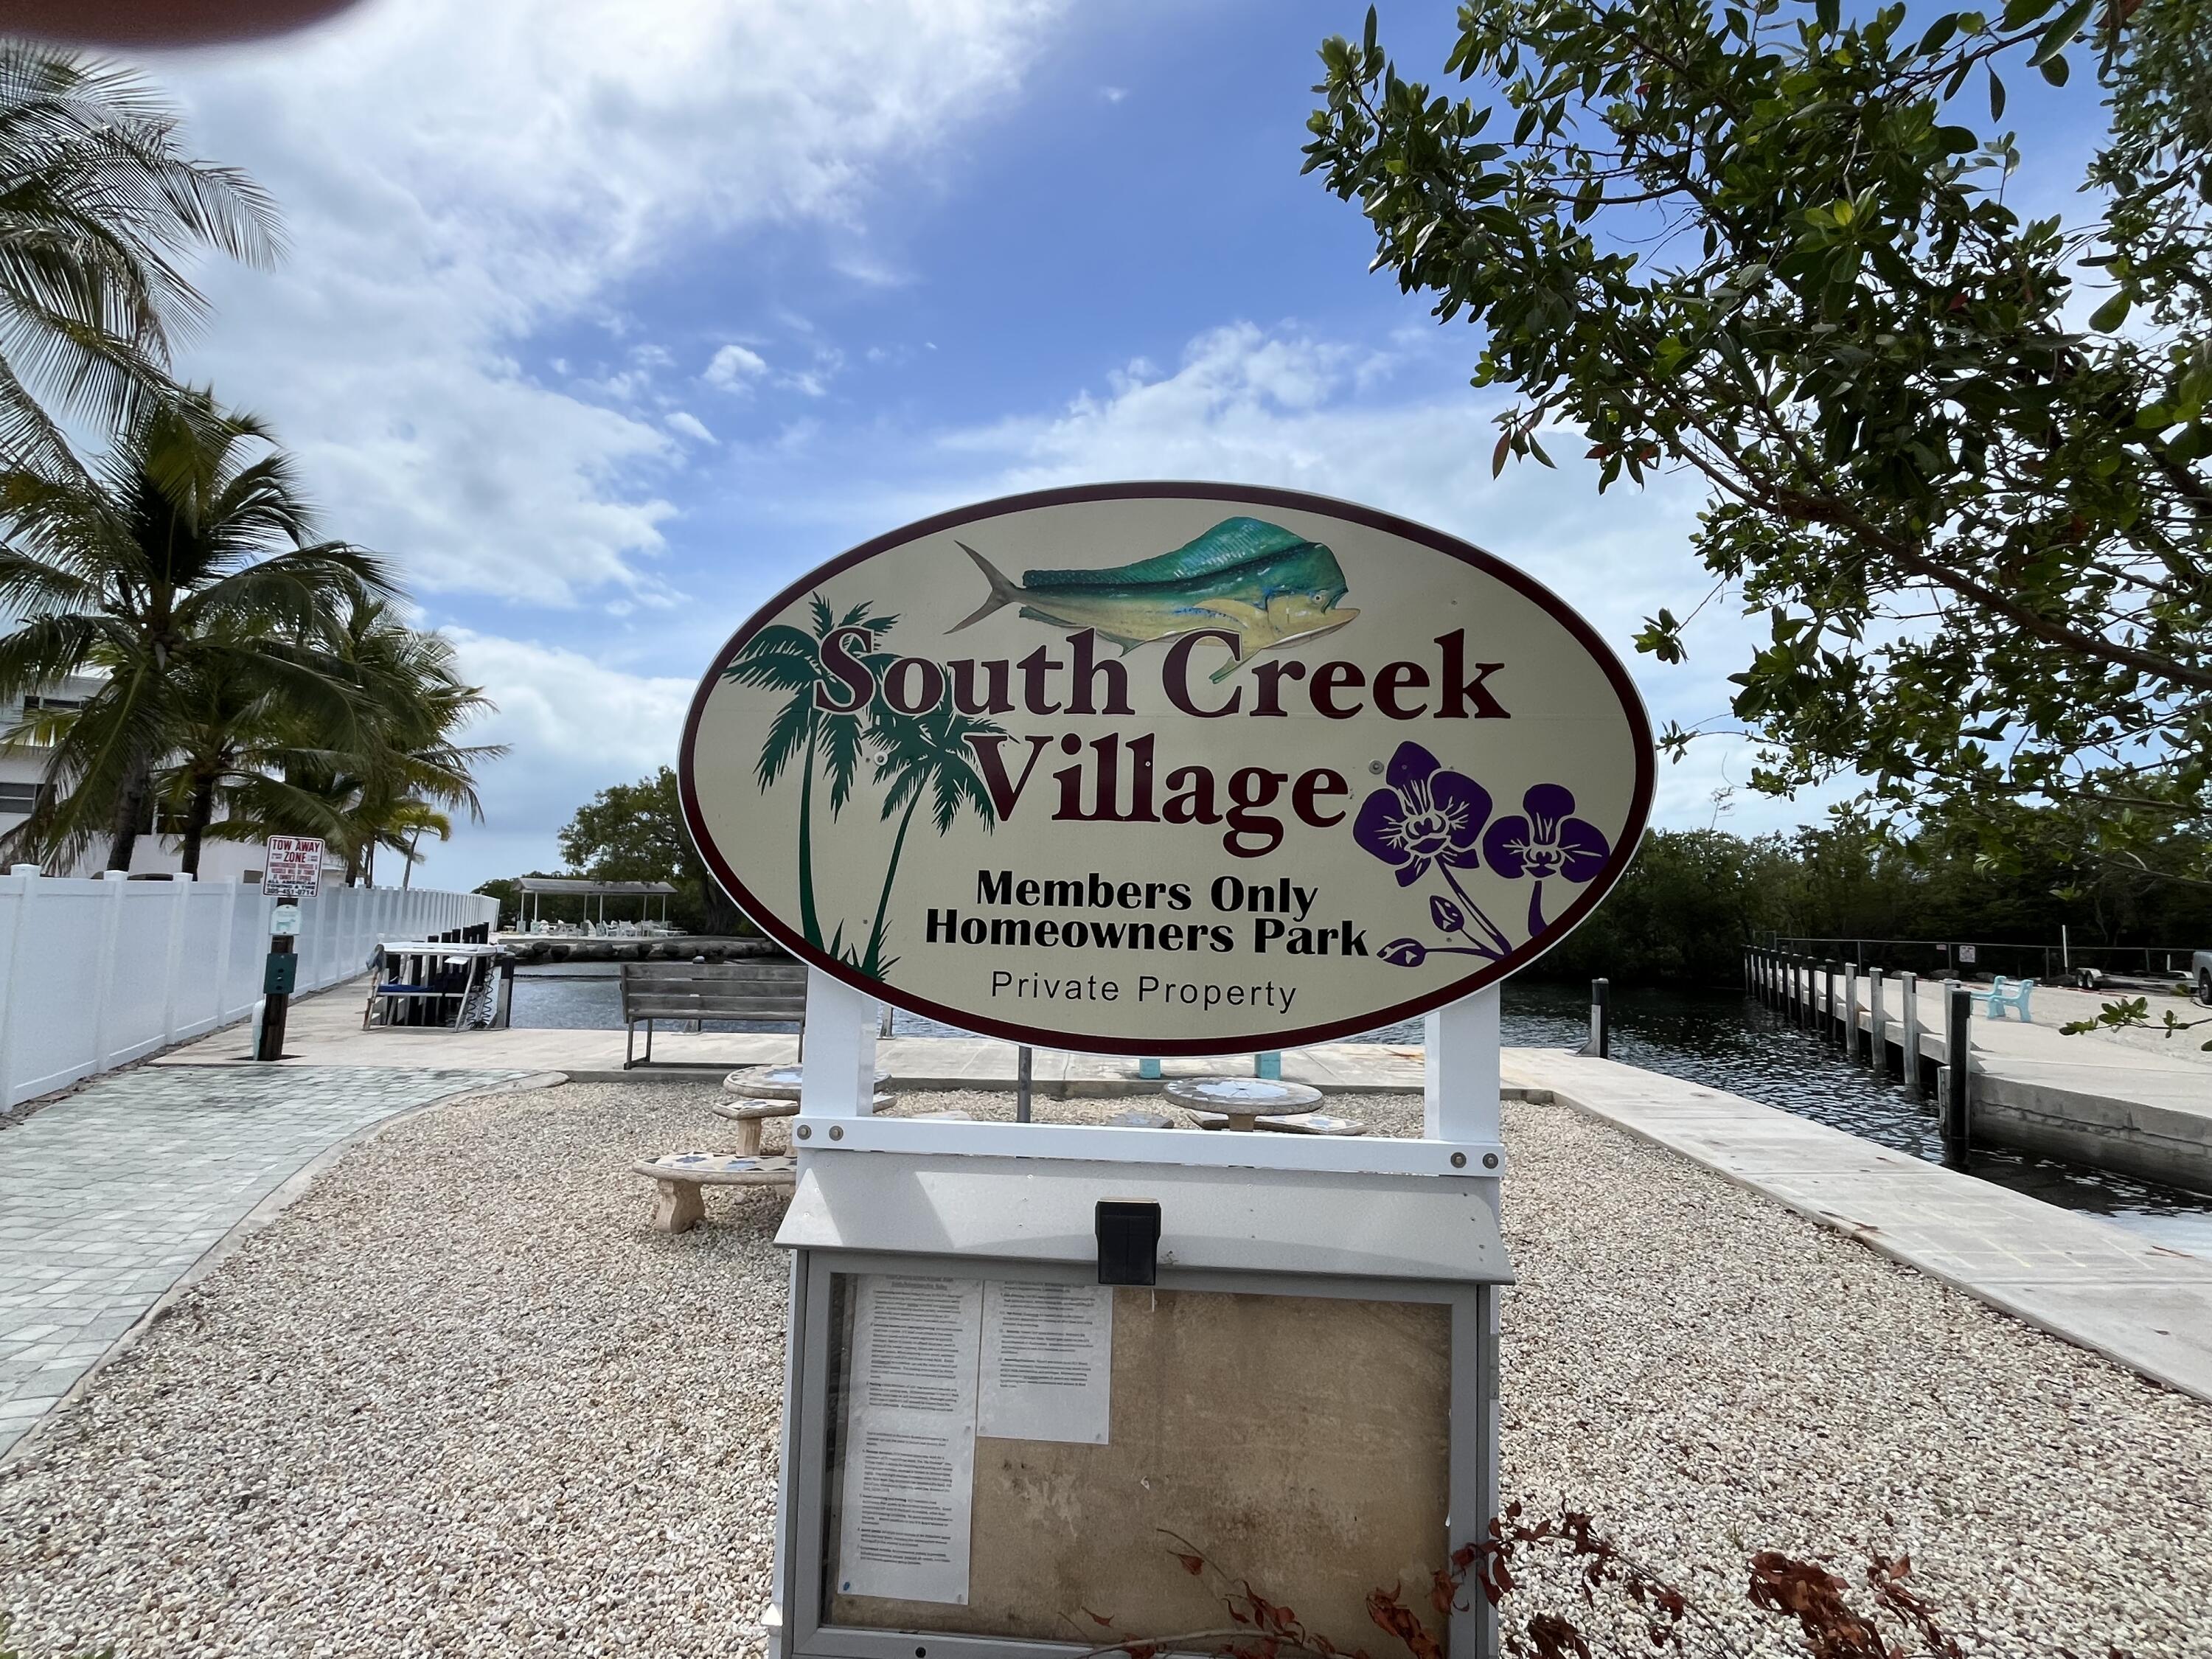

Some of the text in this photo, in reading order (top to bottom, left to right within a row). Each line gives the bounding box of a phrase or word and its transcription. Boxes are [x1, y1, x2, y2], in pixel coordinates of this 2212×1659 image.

[815, 627, 1511, 720] South Creek
[964, 732, 1349, 858] Village
[273, 840, 320, 852] TOW AWAY
[283, 852, 307, 863] ZONE
[977, 869, 1318, 922] Members Only
[926, 908, 1369, 956] Homeowners Park
[992, 970, 1297, 1015] Private Property
